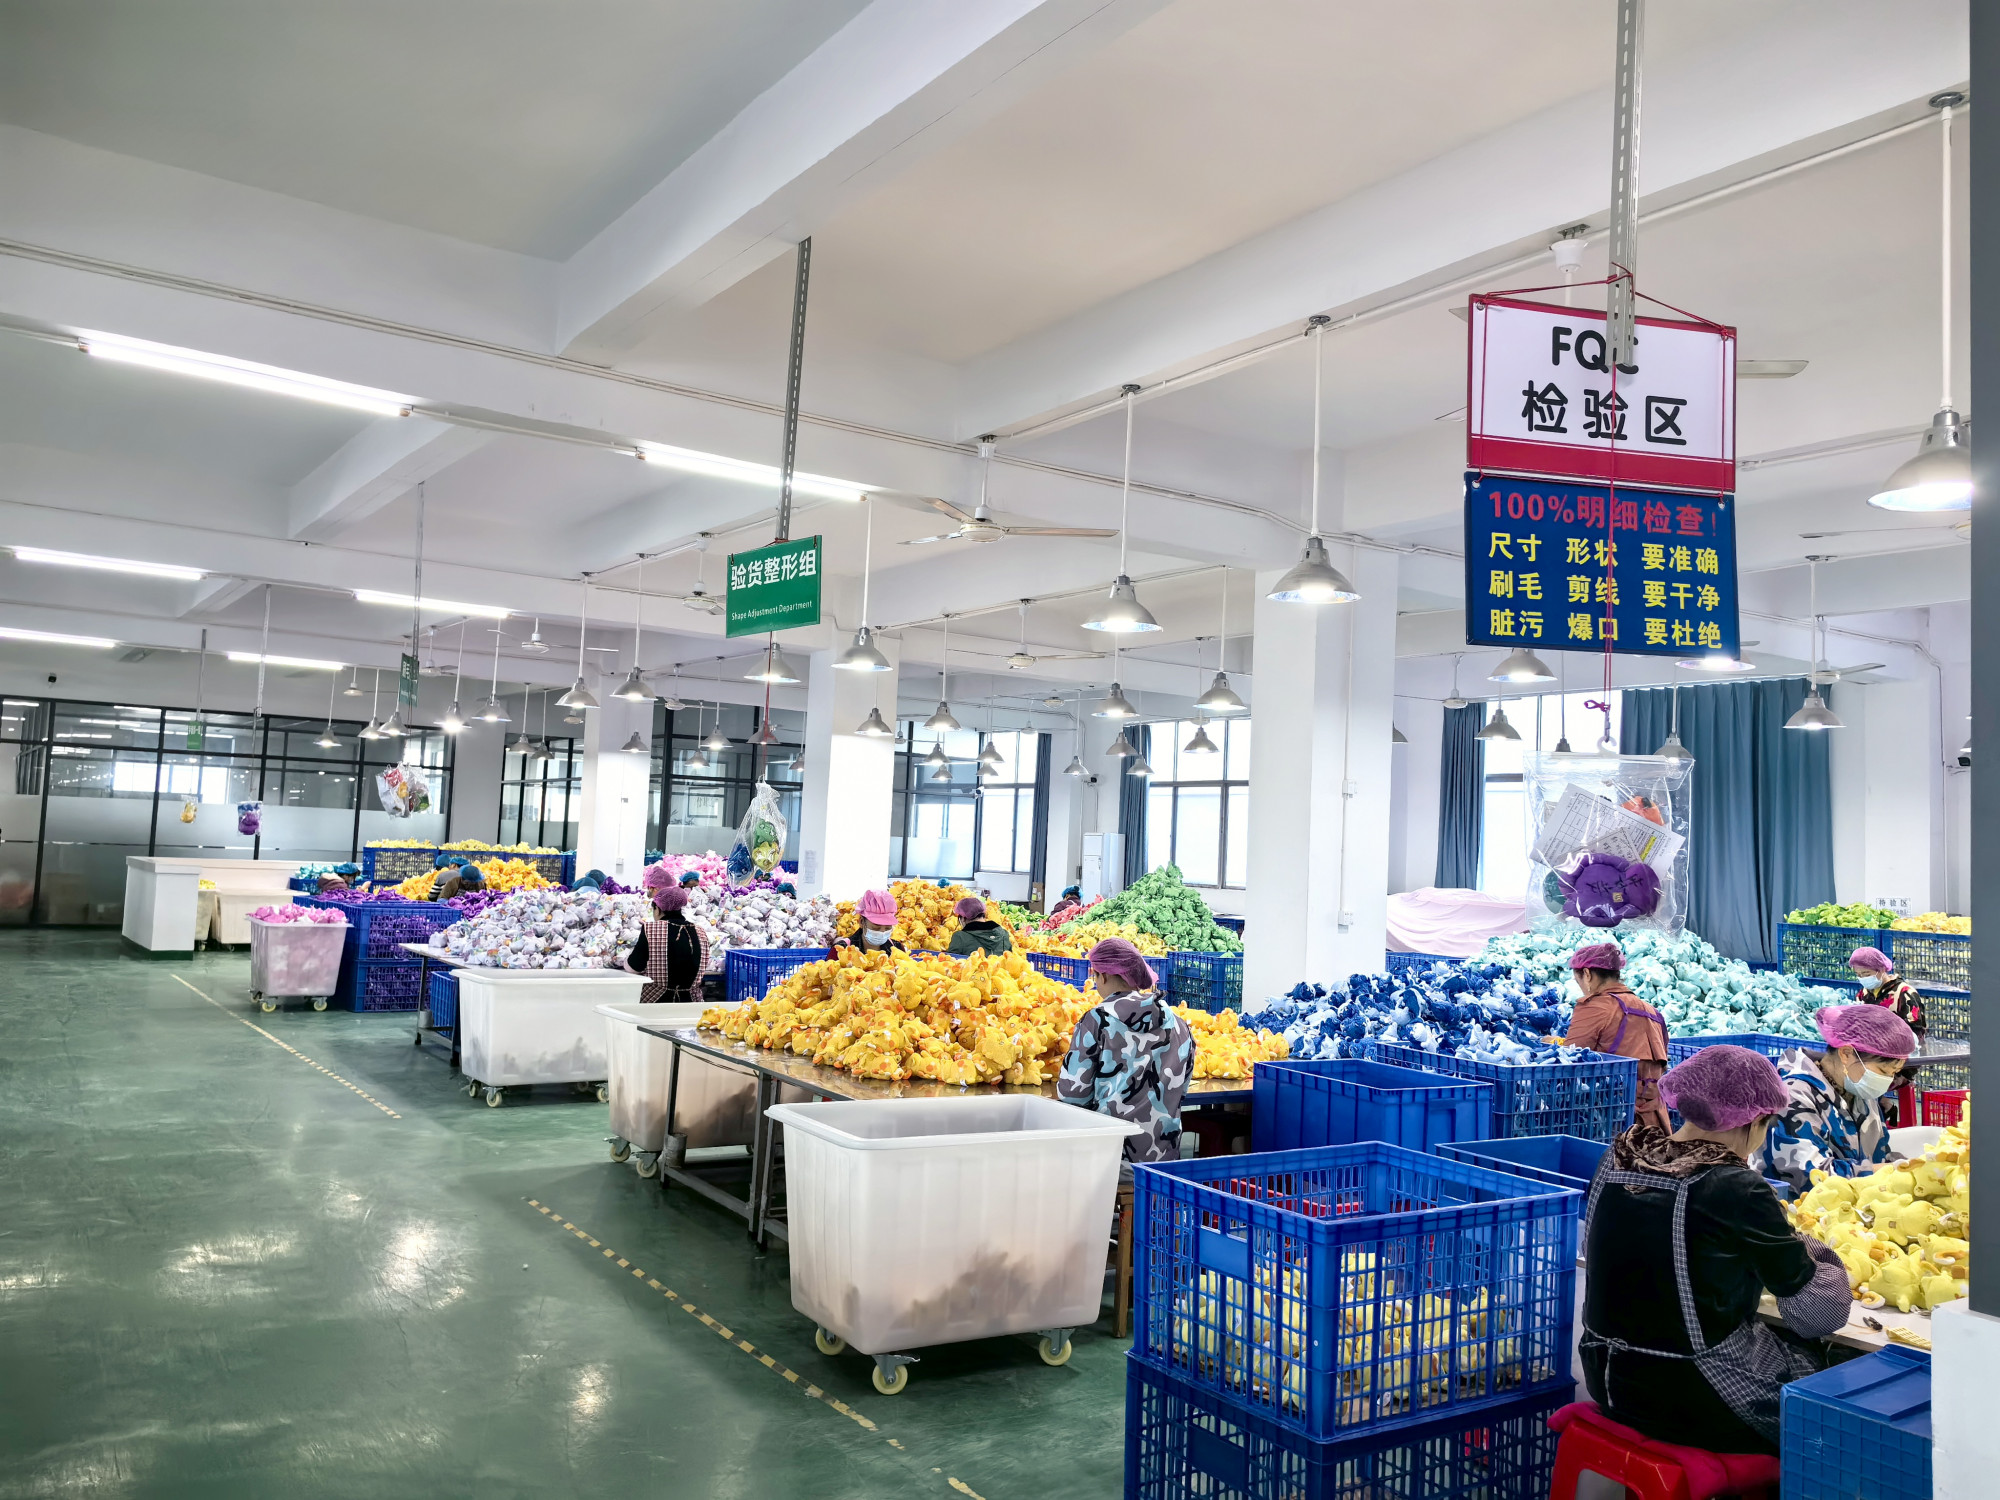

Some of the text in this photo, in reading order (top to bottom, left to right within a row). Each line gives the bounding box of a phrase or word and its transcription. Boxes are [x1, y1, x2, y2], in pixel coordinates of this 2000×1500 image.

[1522, 380, 1687, 445] 检验区
[731, 549, 816, 590] 验货整形组
[1488, 532, 1719, 575] 尺寸 形状 要准确
[731, 600, 812, 621] Shape Adjustment Department
[1489, 570, 1720, 611] 刷毛 剪线 要干净
[1490, 608, 1722, 649] 脏污 爆口 要杜绝
